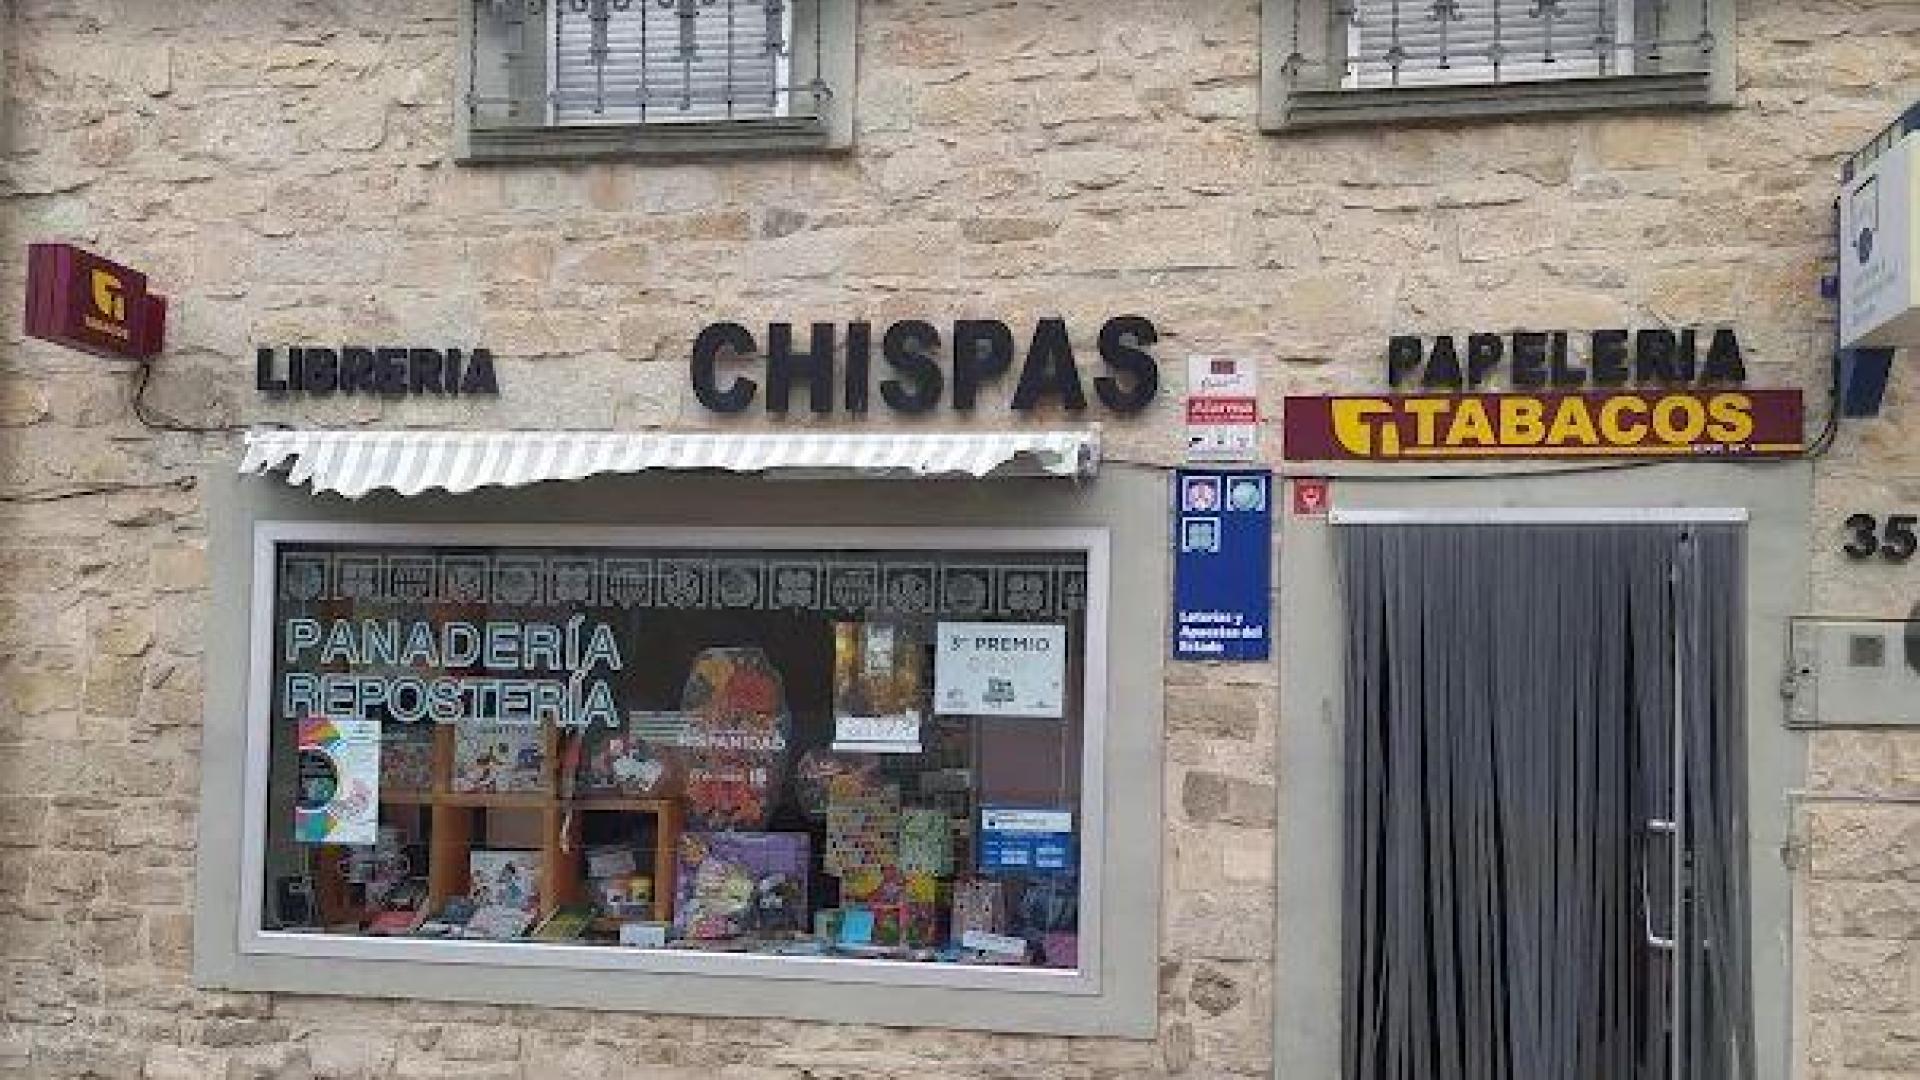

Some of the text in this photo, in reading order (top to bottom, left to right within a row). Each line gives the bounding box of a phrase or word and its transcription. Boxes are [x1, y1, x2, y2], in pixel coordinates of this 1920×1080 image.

[257, 347, 497, 395] LIBRERIA
[691, 316, 1159, 415] CHISPAS
[1388, 329, 1746, 388] PAPELERIA
[1404, 393, 1755, 446] TABACOS
[1844, 513, 1918, 563] 35
[284, 615, 623, 671] PANADERÍA
[975, 637, 1050, 652] PREMIO
[283, 669, 621, 728] REPOSTERÍA
